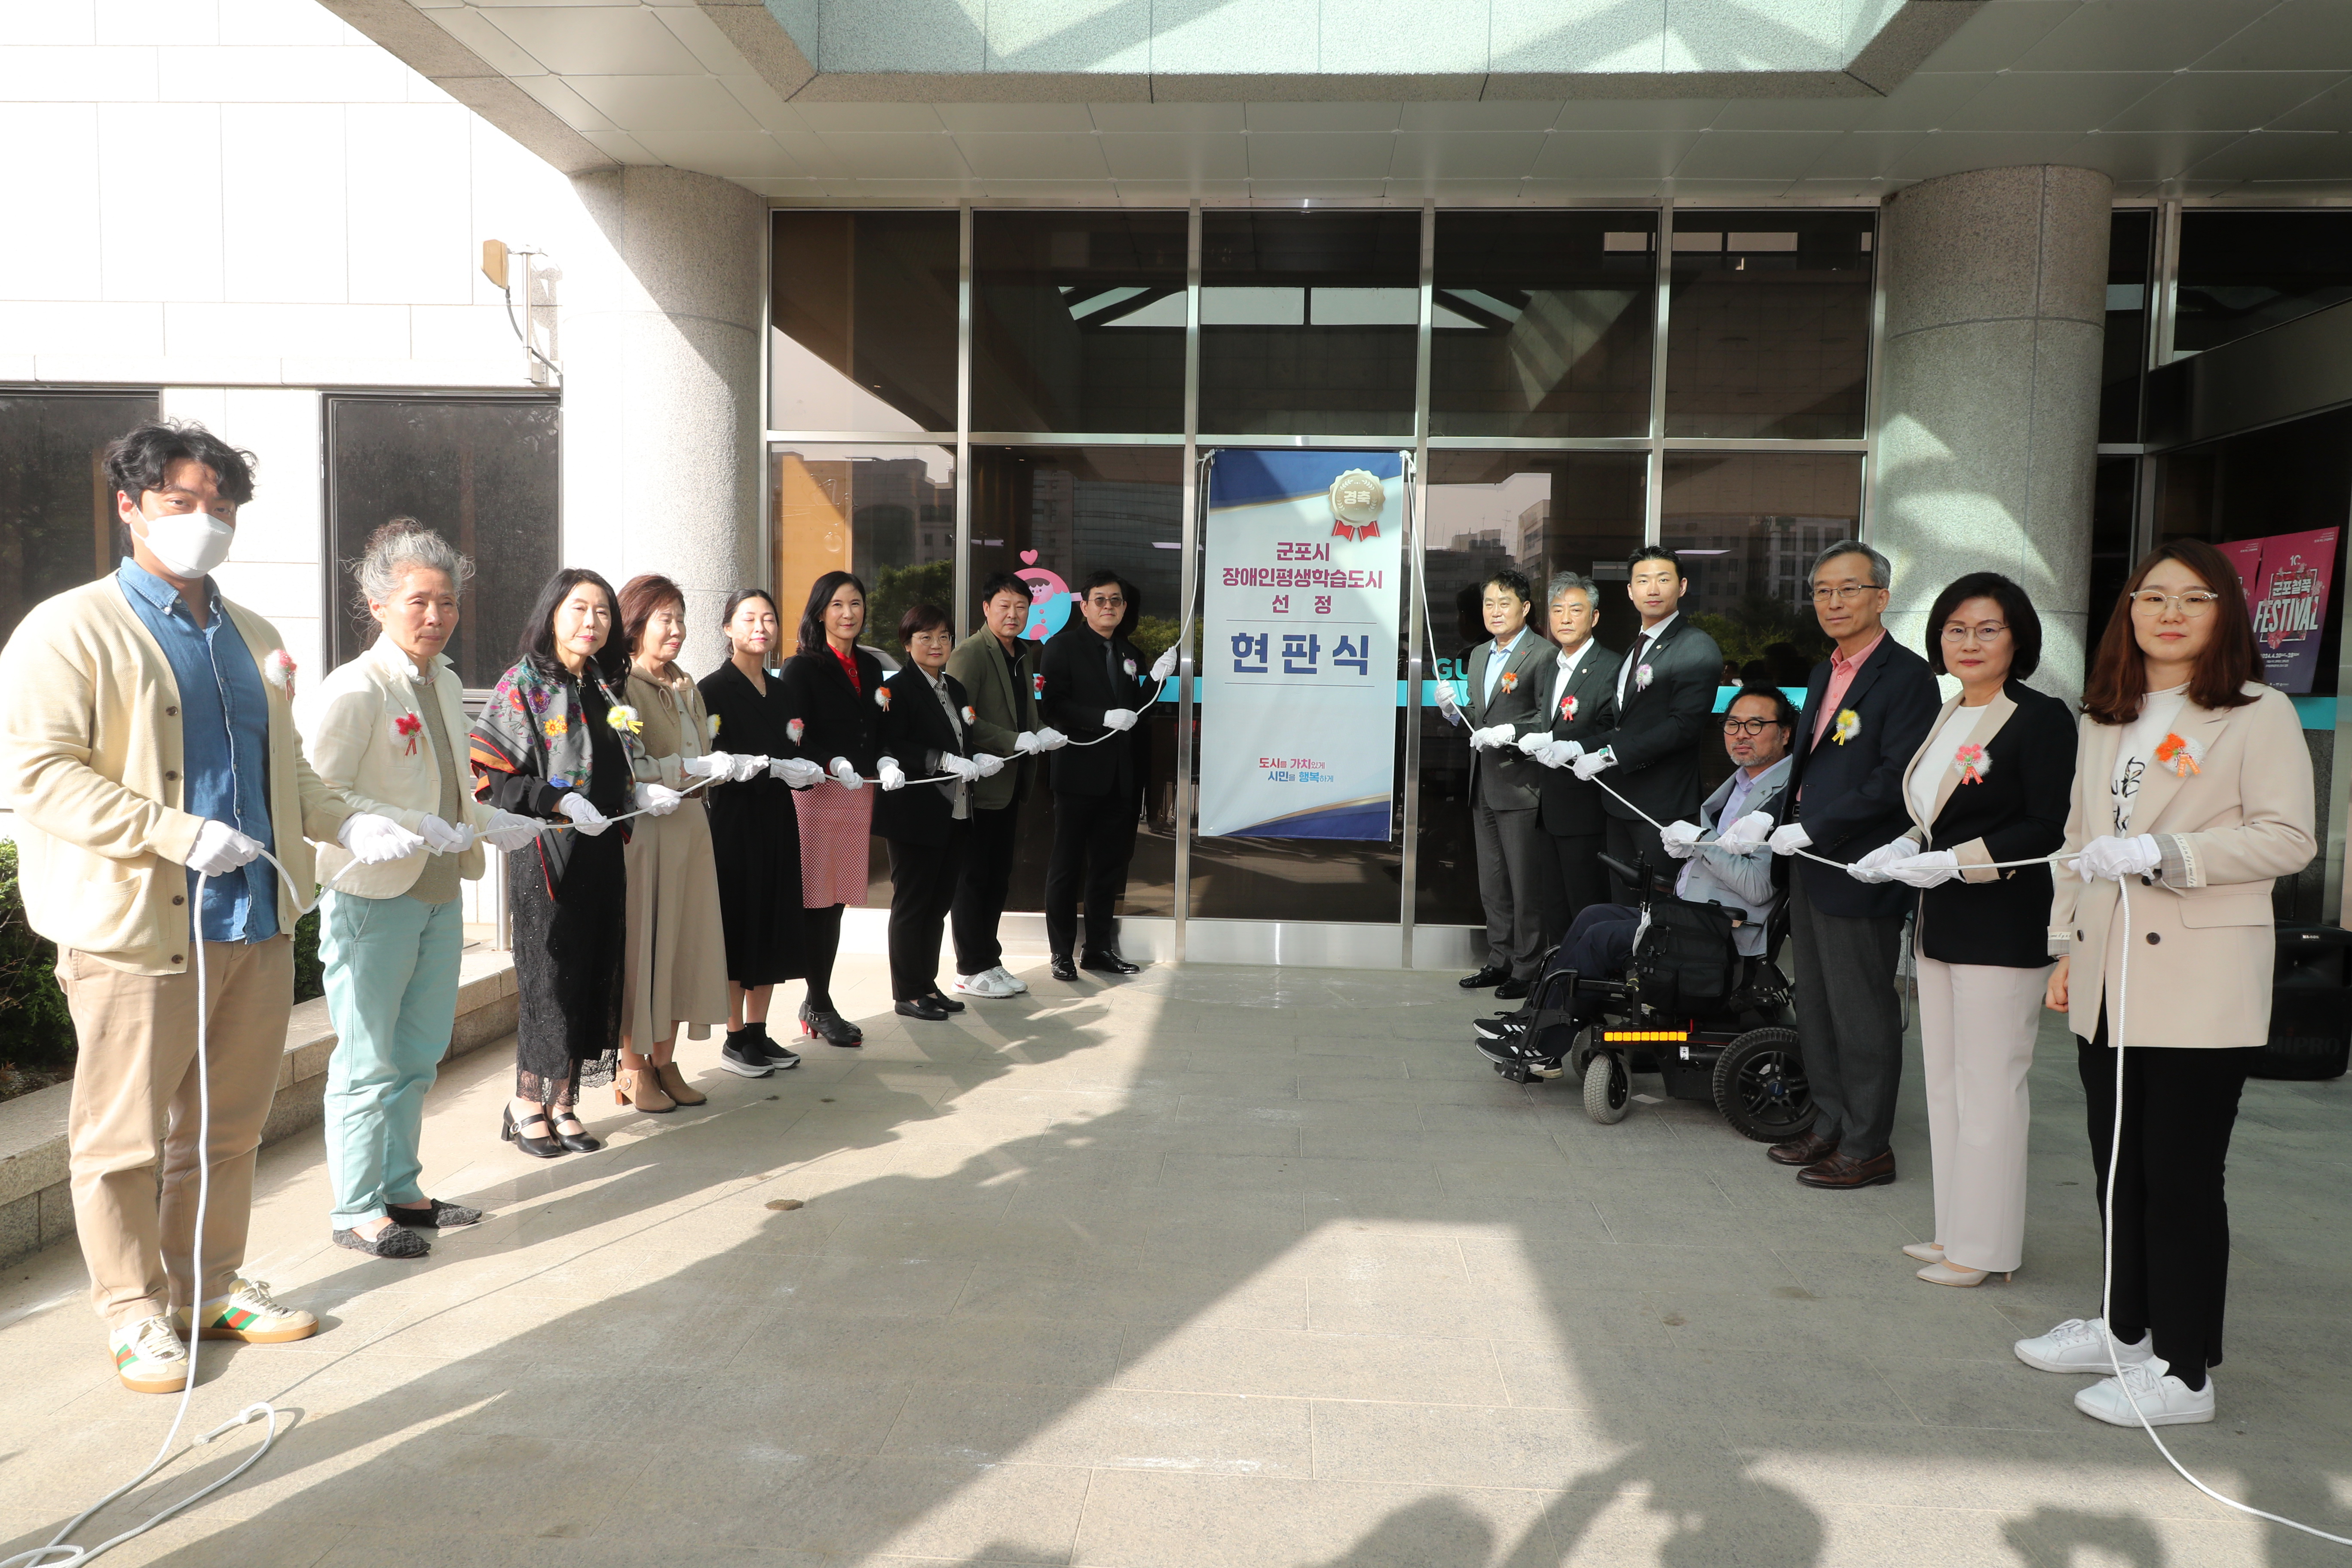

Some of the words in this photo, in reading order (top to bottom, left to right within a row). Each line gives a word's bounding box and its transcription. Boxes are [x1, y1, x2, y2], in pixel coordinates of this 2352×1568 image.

[1344, 490, 1371, 505] 경축
[1276, 542, 1330, 562] 군포시
[1222, 567, 1383, 589] 장애인평생학습도시
[2272, 579, 2312, 597] 군포철쭉
[2253, 596, 2319, 633] FESTIVAL
[1259, 757, 1287, 769] 도시를
[1290, 758, 1325, 770] 가치있게
[1268, 771, 1296, 782] 시민을
[1299, 772, 1334, 783] 행복하게
